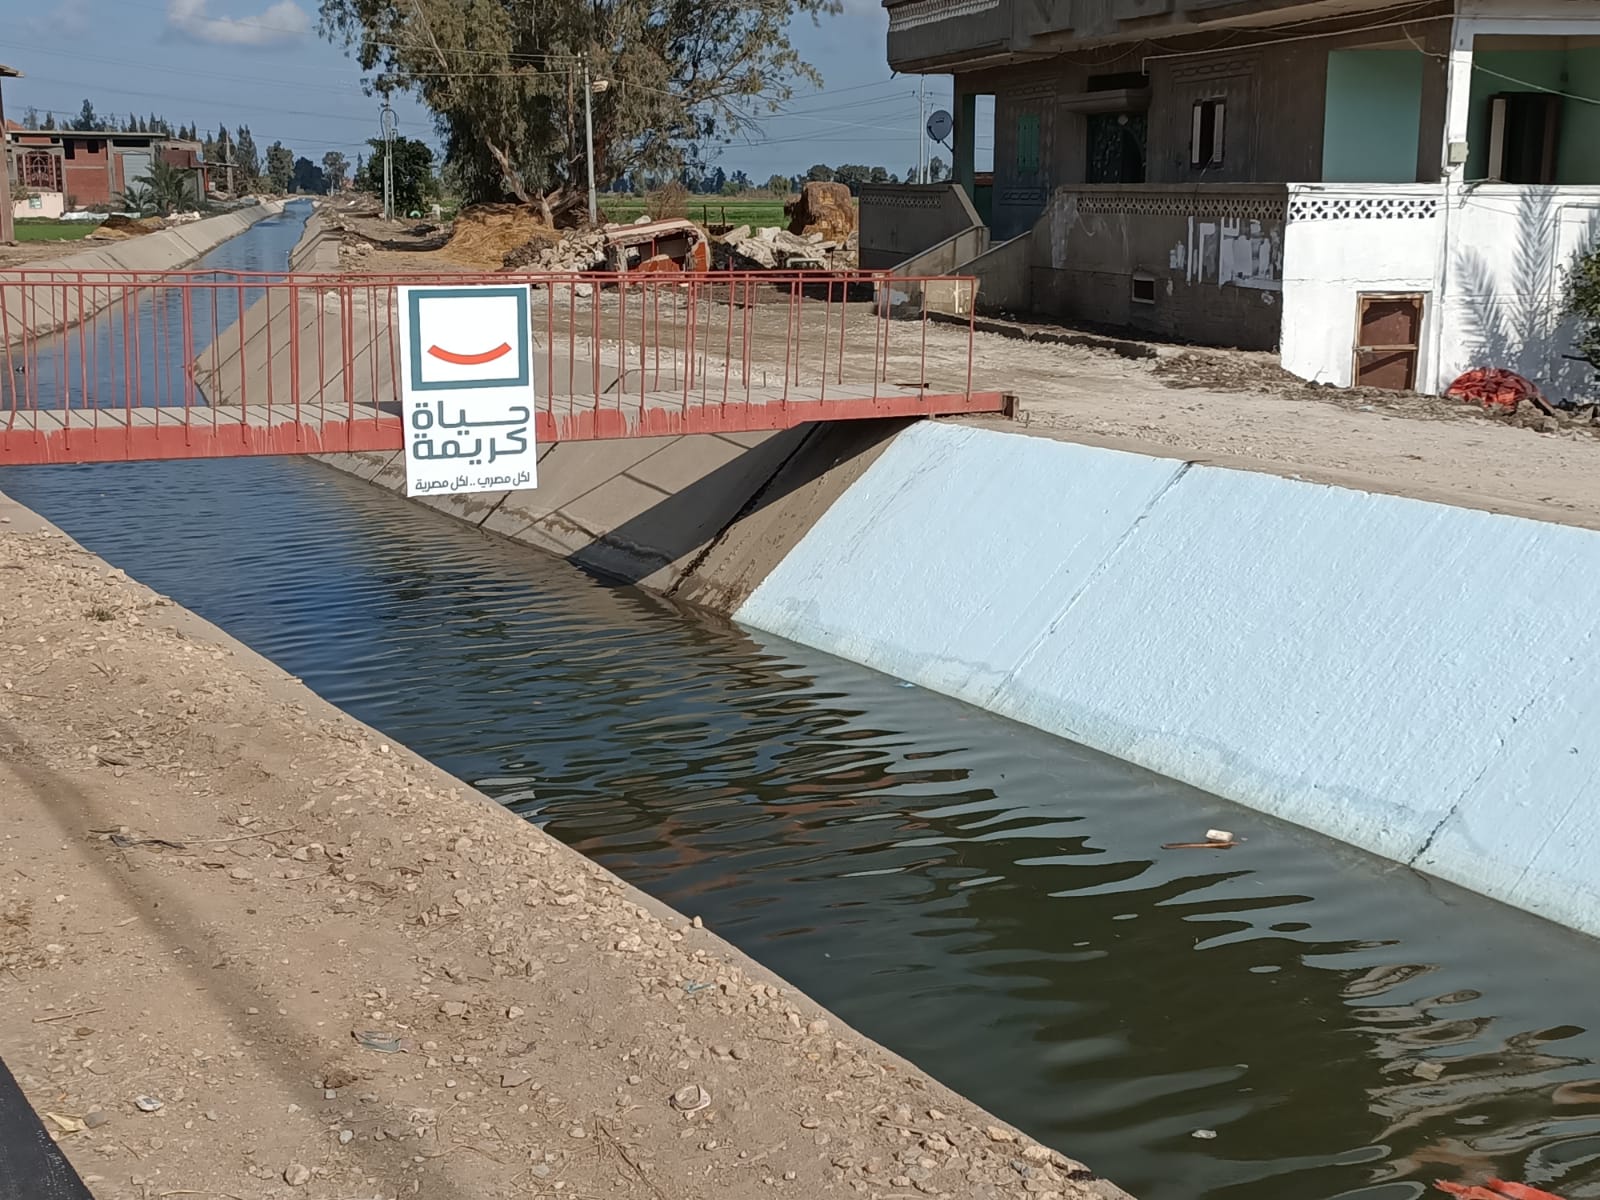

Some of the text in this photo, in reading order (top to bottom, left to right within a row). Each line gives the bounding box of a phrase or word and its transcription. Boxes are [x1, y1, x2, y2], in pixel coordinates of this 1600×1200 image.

[412, 400, 530, 435] حياة
[413, 427, 527, 465] كريمة
[415, 478, 448, 492] مصرية
[450, 475, 468, 491] لكل
[513, 471, 530, 486] لكل
